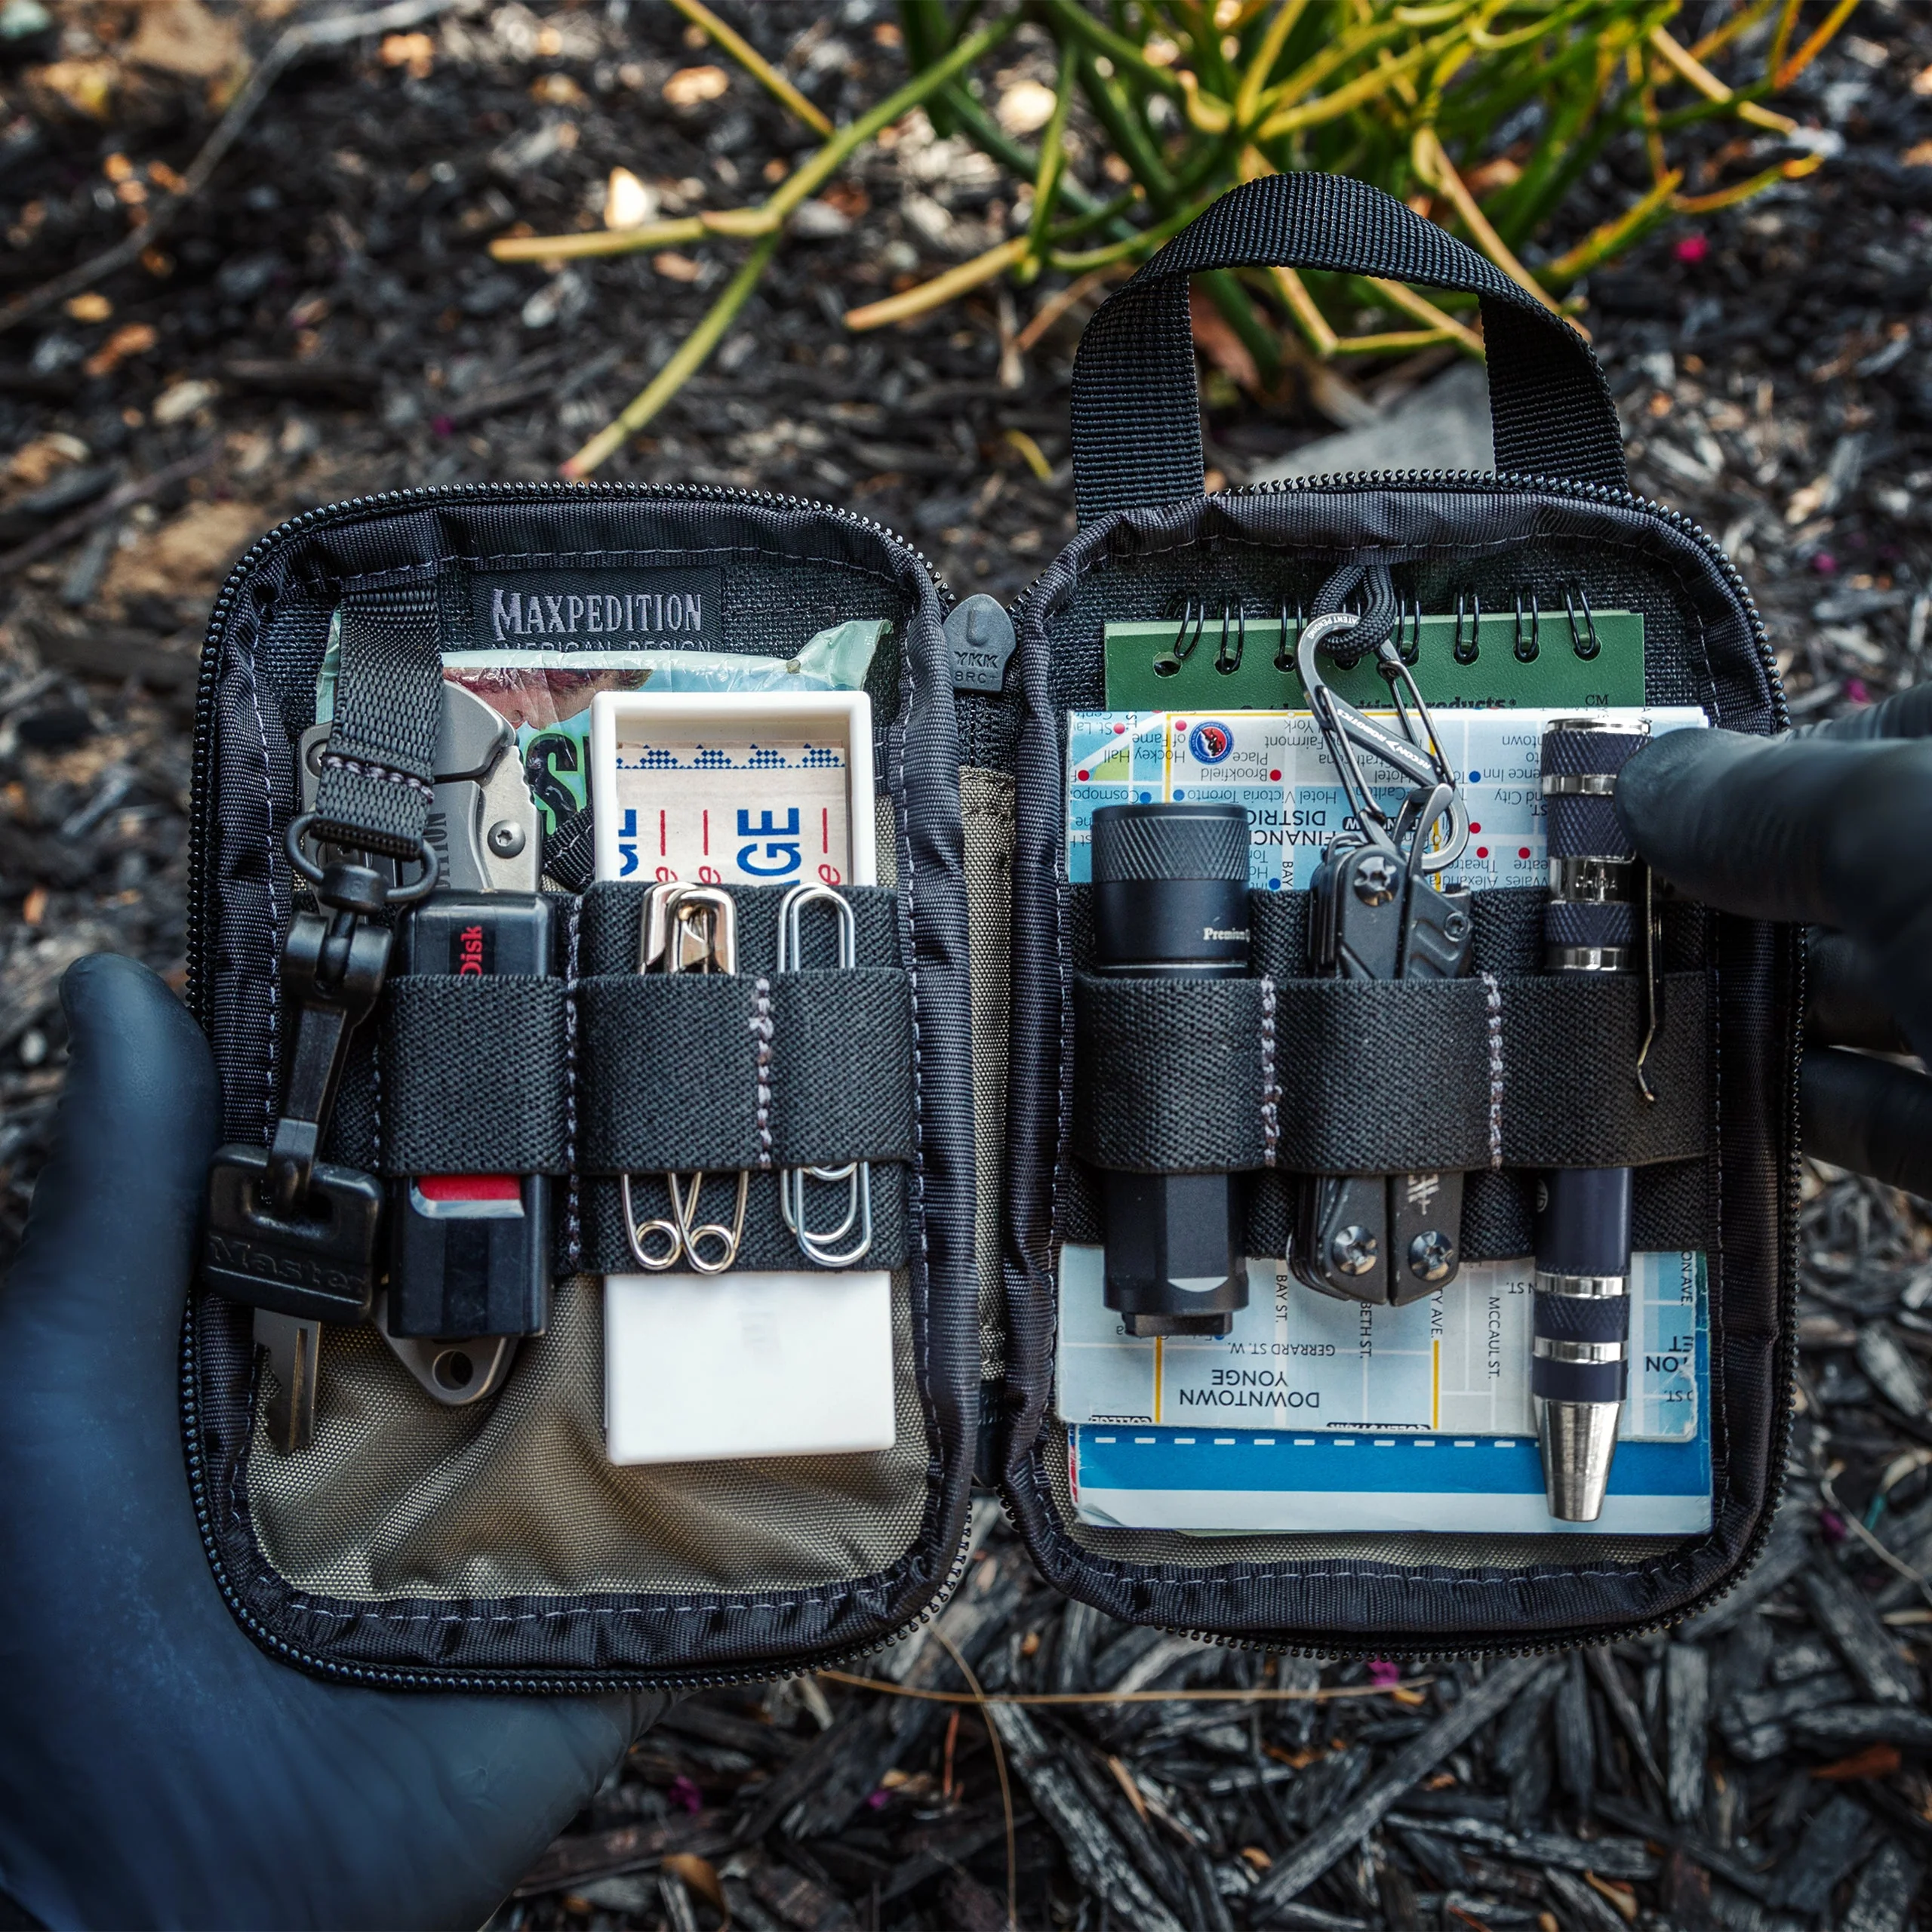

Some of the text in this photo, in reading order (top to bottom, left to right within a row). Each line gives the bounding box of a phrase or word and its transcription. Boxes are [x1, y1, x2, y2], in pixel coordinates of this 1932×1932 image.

[954, 651, 998, 668] YKK
[1284, 720, 1313, 733] York
[1337, 710, 1386, 742] ROBOTICS
[1133, 734, 1186, 745] of Fame
[1265, 737, 1324, 749] Fairmont
[1104, 747, 1185, 762] Hockey Hall
[1233, 752, 1267, 765] Place
[1396, 746, 1432, 769] RECON
[1201, 768, 1267, 781] Brookfield
[1484, 769, 1503, 782] Inn
[1188, 790, 1337, 804] Hotel Victoria Toronto
[1494, 789, 1521, 804] City
[1282, 862, 1293, 887] BAY
[1506, 1282, 1524, 1294] ST.
[1681, 1275, 1693, 1306] AVE.
[1275, 1275, 1287, 1323] BAY ST.
[1432, 1308, 1442, 1339] AVE.
[1488, 1297, 1500, 1380] MCCAUL ST.
[1228, 1343, 1335, 1357] GERRARD ST. W.
[1359, 1341, 1371, 1359] ST.
[1212, 1370, 1288, 1387] YONGE
[1180, 1389, 1320, 1408] DOWNTOWN
[1664, 1391, 1683, 1401] ST.
